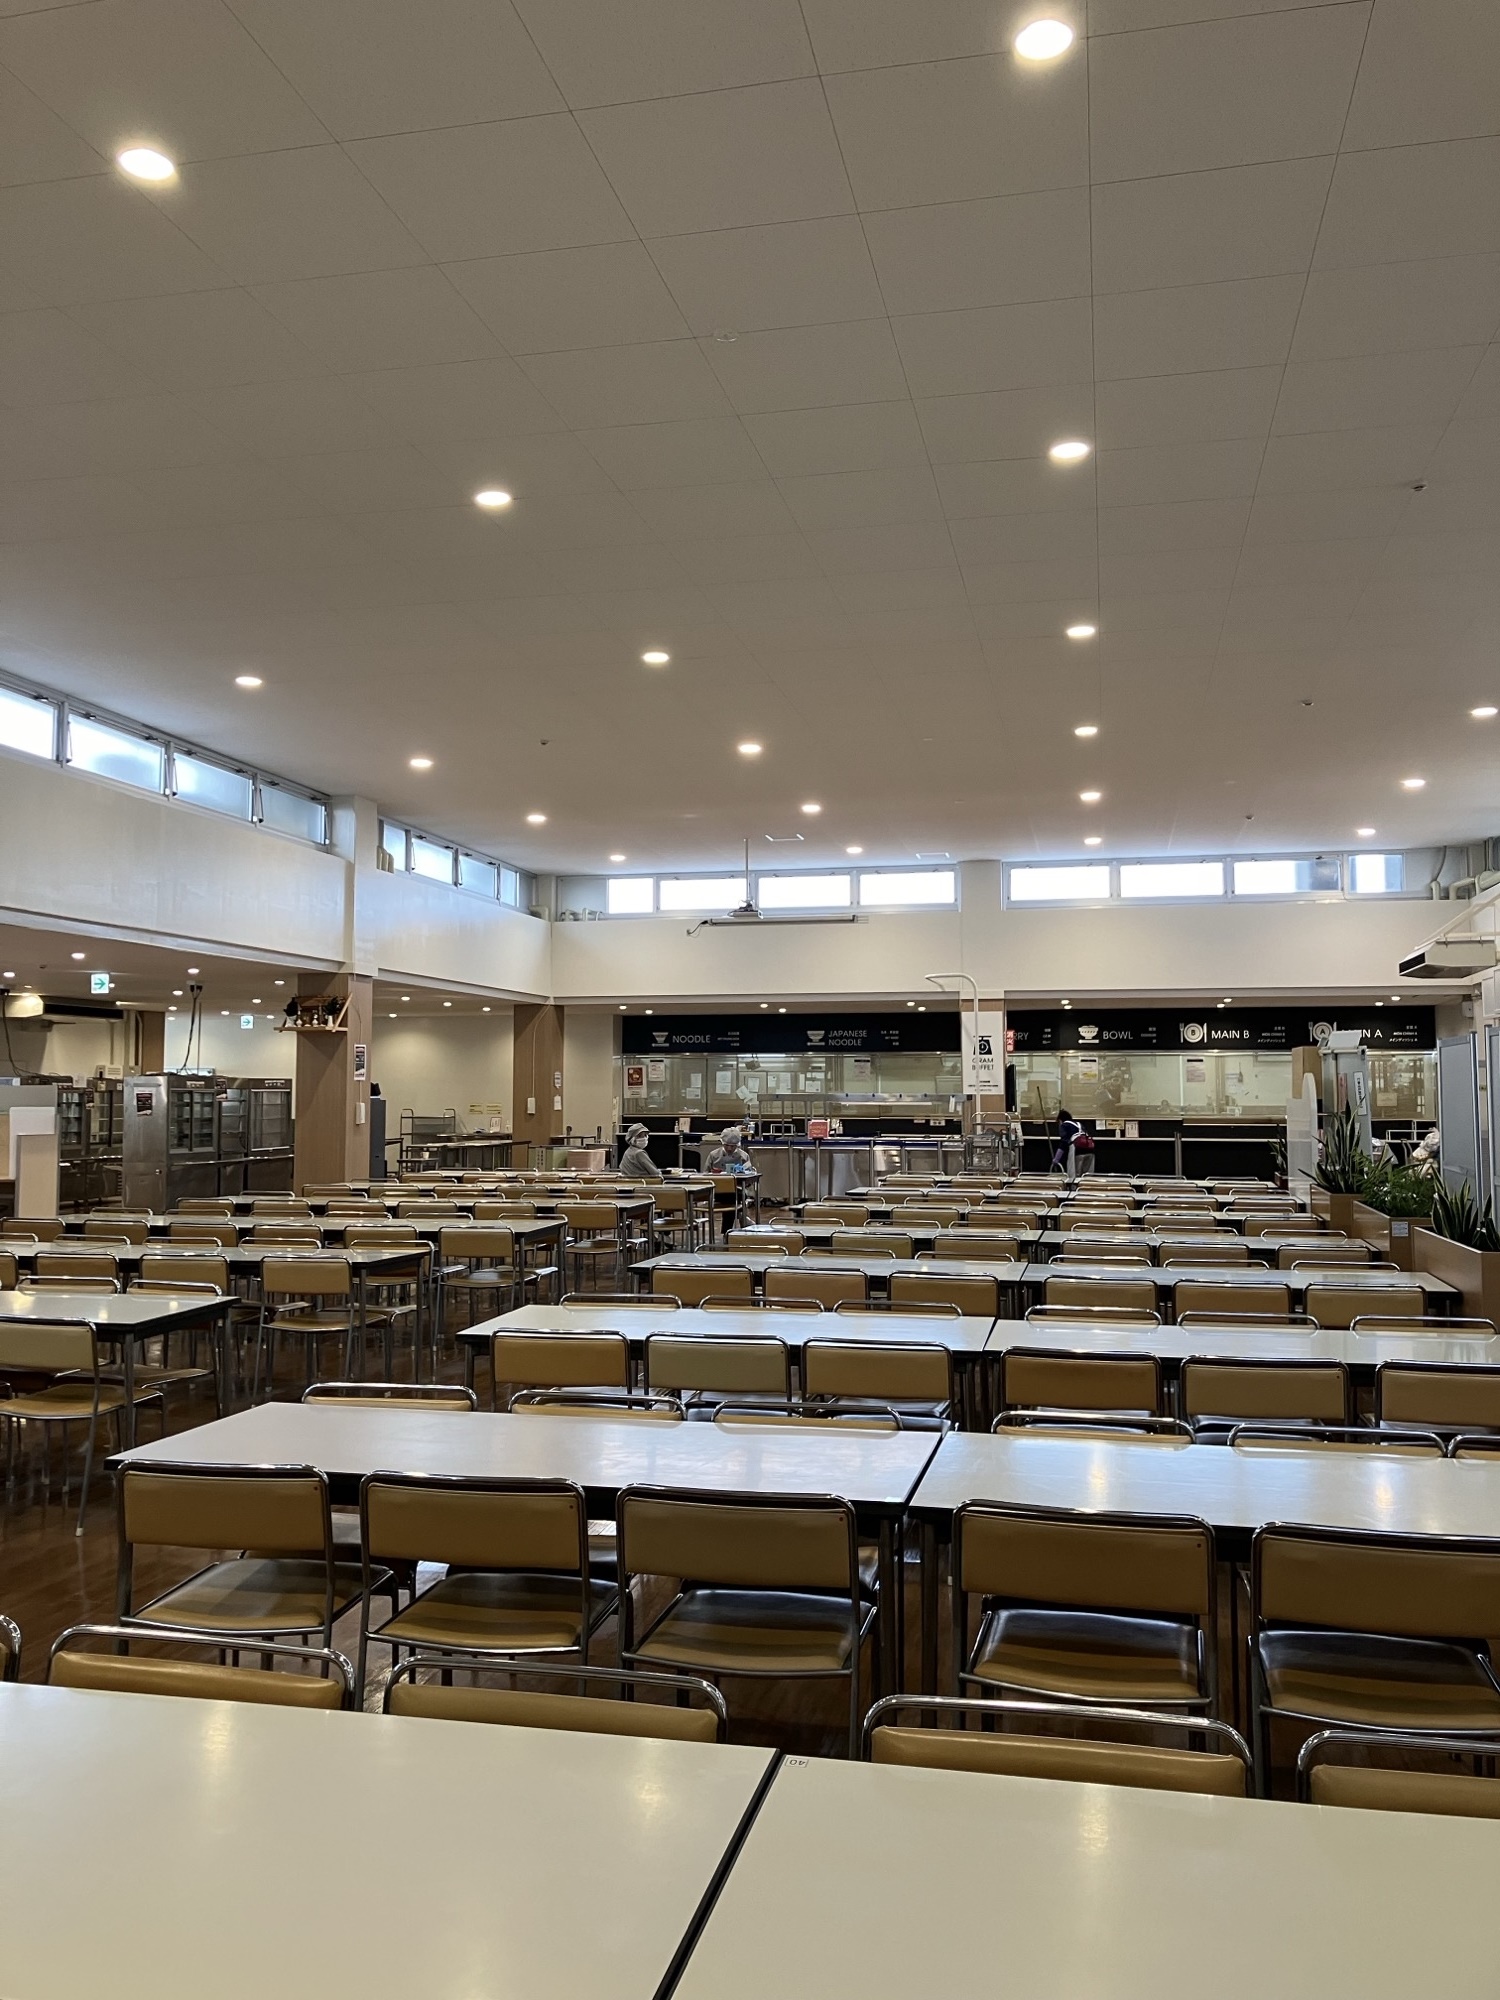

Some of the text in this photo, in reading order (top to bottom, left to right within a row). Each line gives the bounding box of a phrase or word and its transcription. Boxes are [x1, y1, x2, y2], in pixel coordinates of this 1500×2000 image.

[828, 1030, 868, 1038] JAPANESE
[1102, 1030, 1133, 1040] BOWL
[1211, 1030, 1250, 1039] MAIN B
[1374, 1029, 1383, 1038] A
[672, 1034, 711, 1043] NOODLE
[828, 1038, 862, 1046] NOODLE
